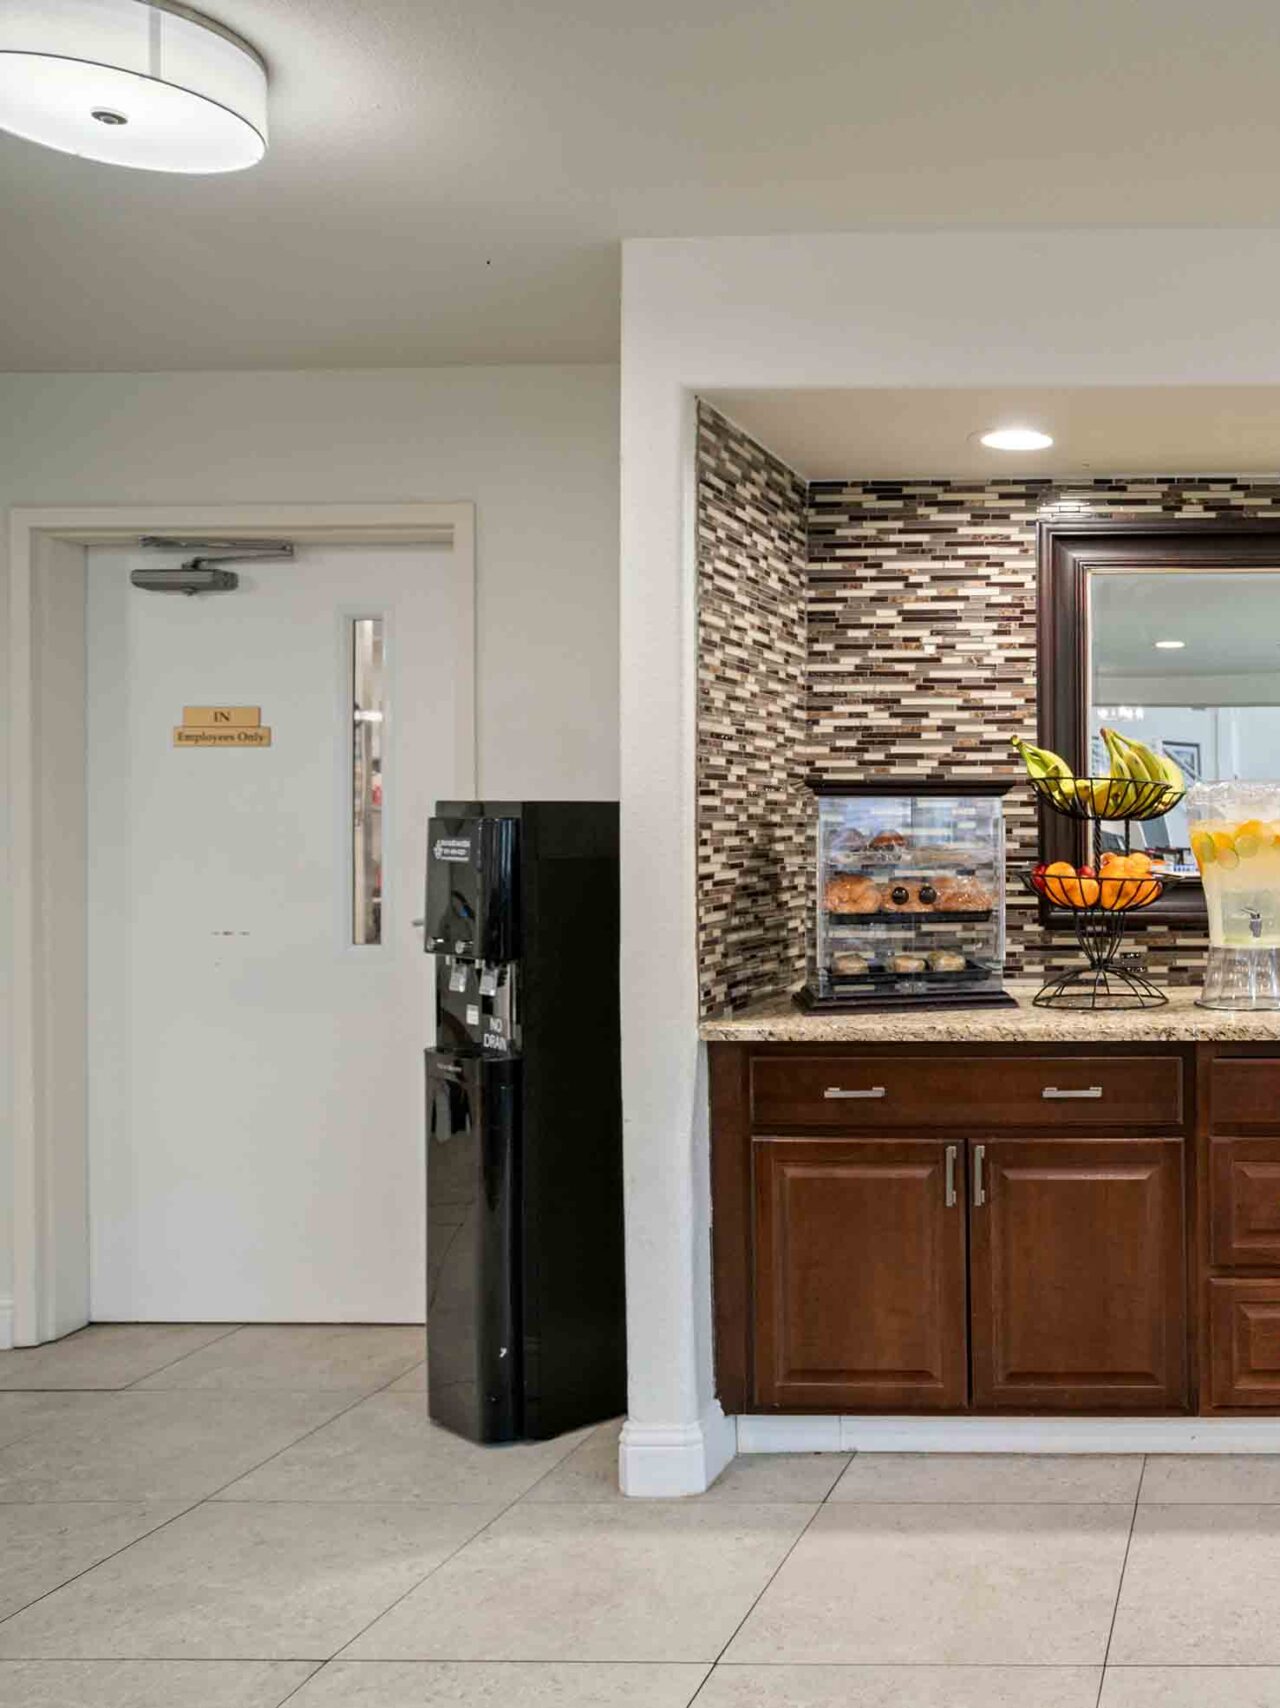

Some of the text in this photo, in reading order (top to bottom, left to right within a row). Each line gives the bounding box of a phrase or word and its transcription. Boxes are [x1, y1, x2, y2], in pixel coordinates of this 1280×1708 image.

[213, 711, 231, 722] IN
[177, 731, 263, 744] Employees Only
[490, 1017, 503, 1033] NO
[483, 1033, 507, 1052] DRAIN
